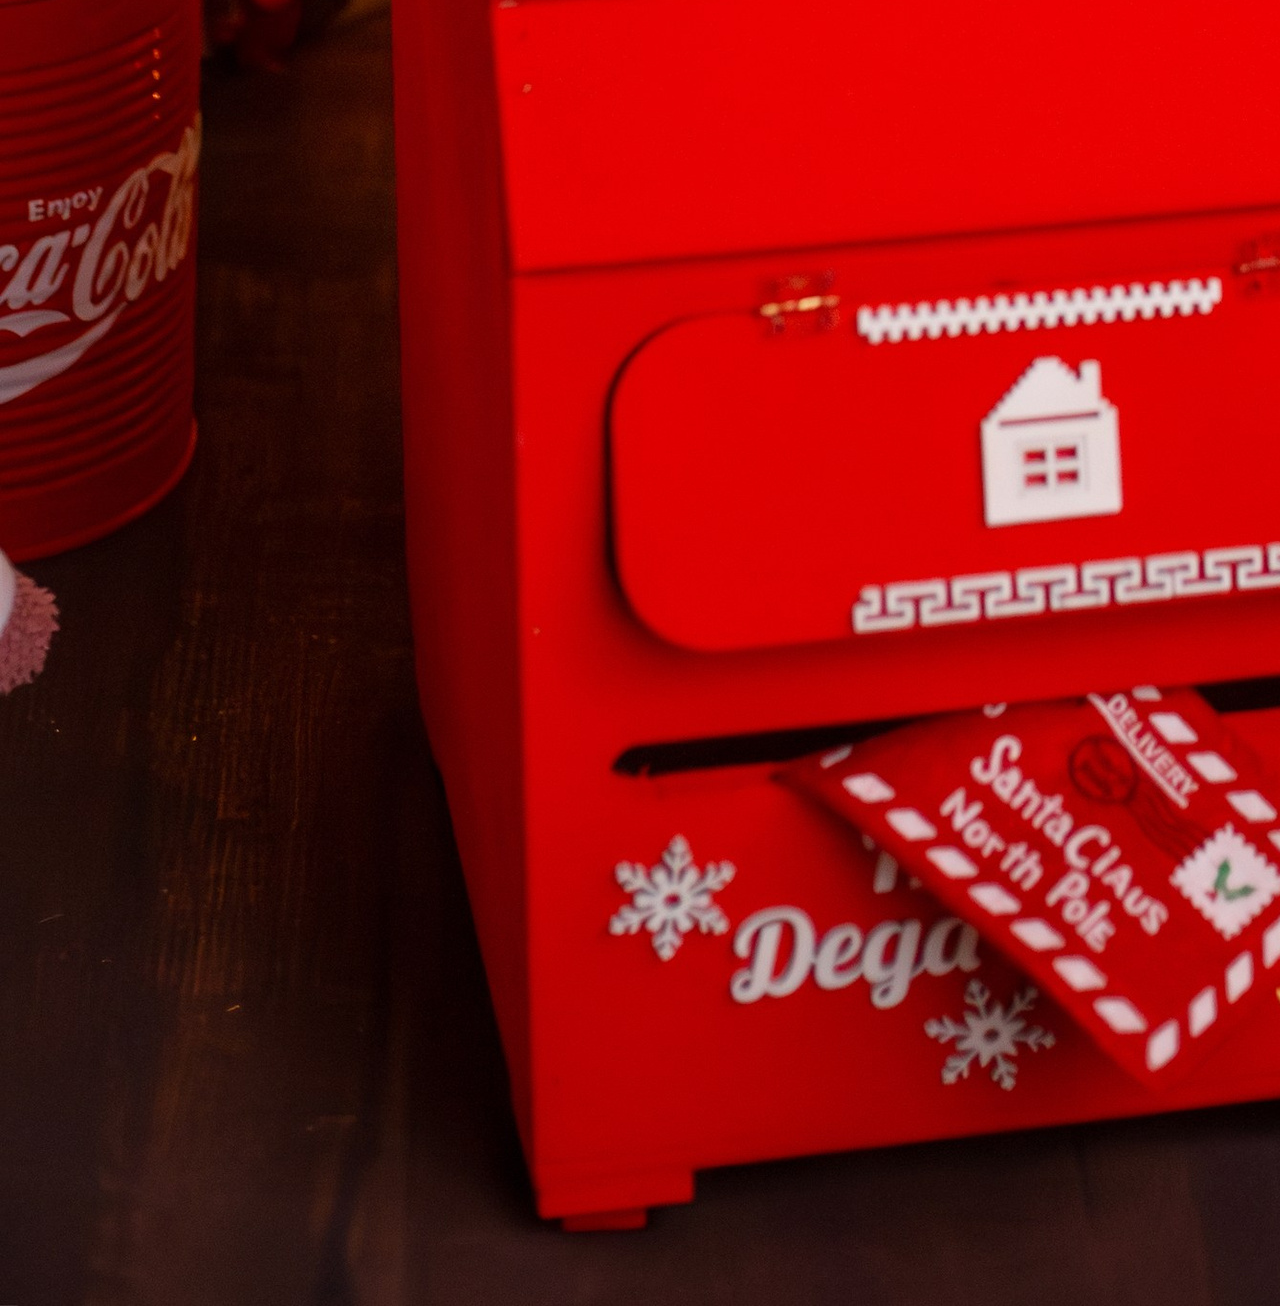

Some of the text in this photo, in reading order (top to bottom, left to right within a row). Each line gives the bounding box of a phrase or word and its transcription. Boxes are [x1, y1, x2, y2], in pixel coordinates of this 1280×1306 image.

[28, 186, 103, 222] Enjoy
[1106, 692, 1199, 797] DELIVERY
[940, 786, 1044, 892] North
